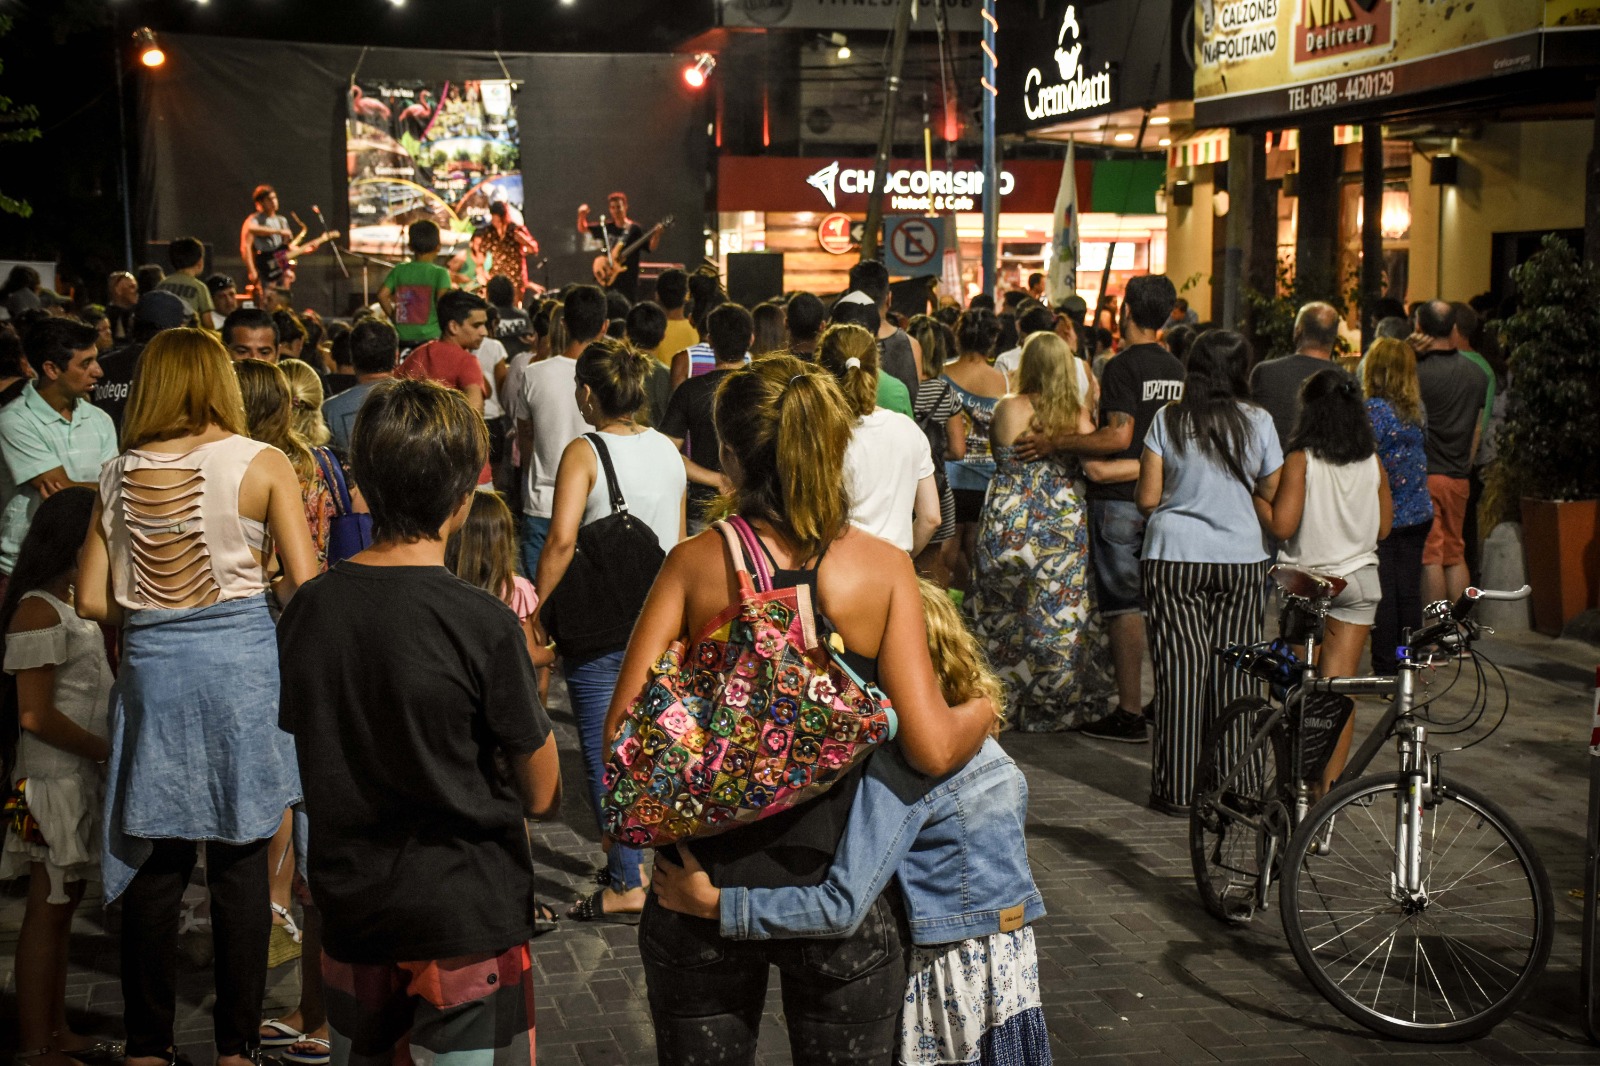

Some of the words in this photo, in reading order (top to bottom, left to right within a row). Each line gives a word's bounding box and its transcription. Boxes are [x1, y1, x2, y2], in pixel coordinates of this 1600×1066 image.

[1222, 0, 1277, 28] CALZONES
[1203, 30, 1277, 65] NAPOLITANO
[1306, 24, 1374, 51] Delivery
[1024, 61, 1111, 121] Cremolatti
[1310, 82, 1337, 107] 0348
[1344, 70, 1395, 102] 4420129
[904, 226, 924, 256] E
